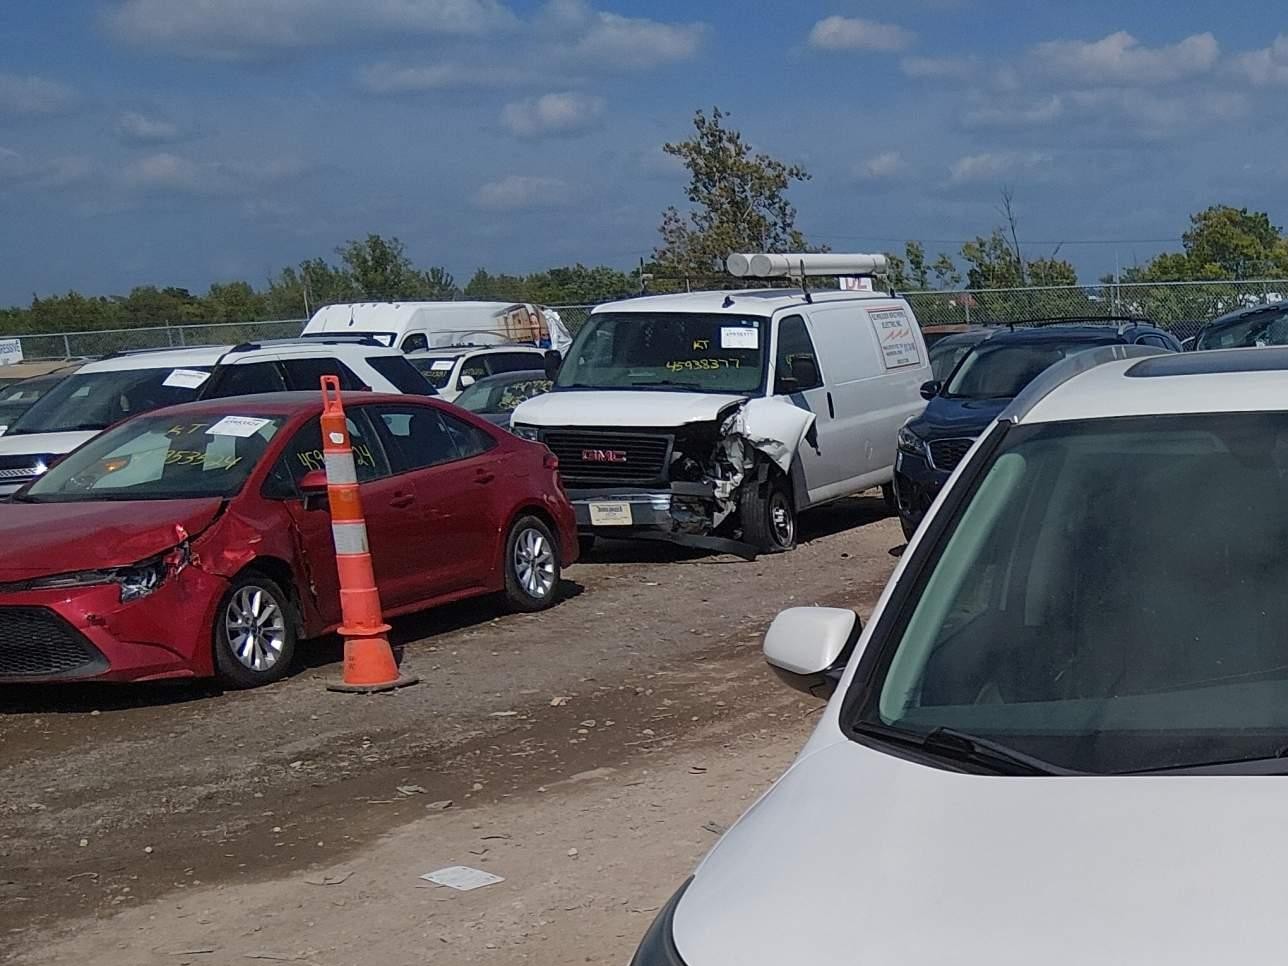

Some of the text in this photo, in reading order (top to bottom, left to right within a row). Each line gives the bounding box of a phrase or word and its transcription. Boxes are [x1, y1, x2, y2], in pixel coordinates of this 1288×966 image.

[693, 339, 710, 350] KT
[666, 358, 740, 372] 45938377
[582, 449, 627, 462] GMC
